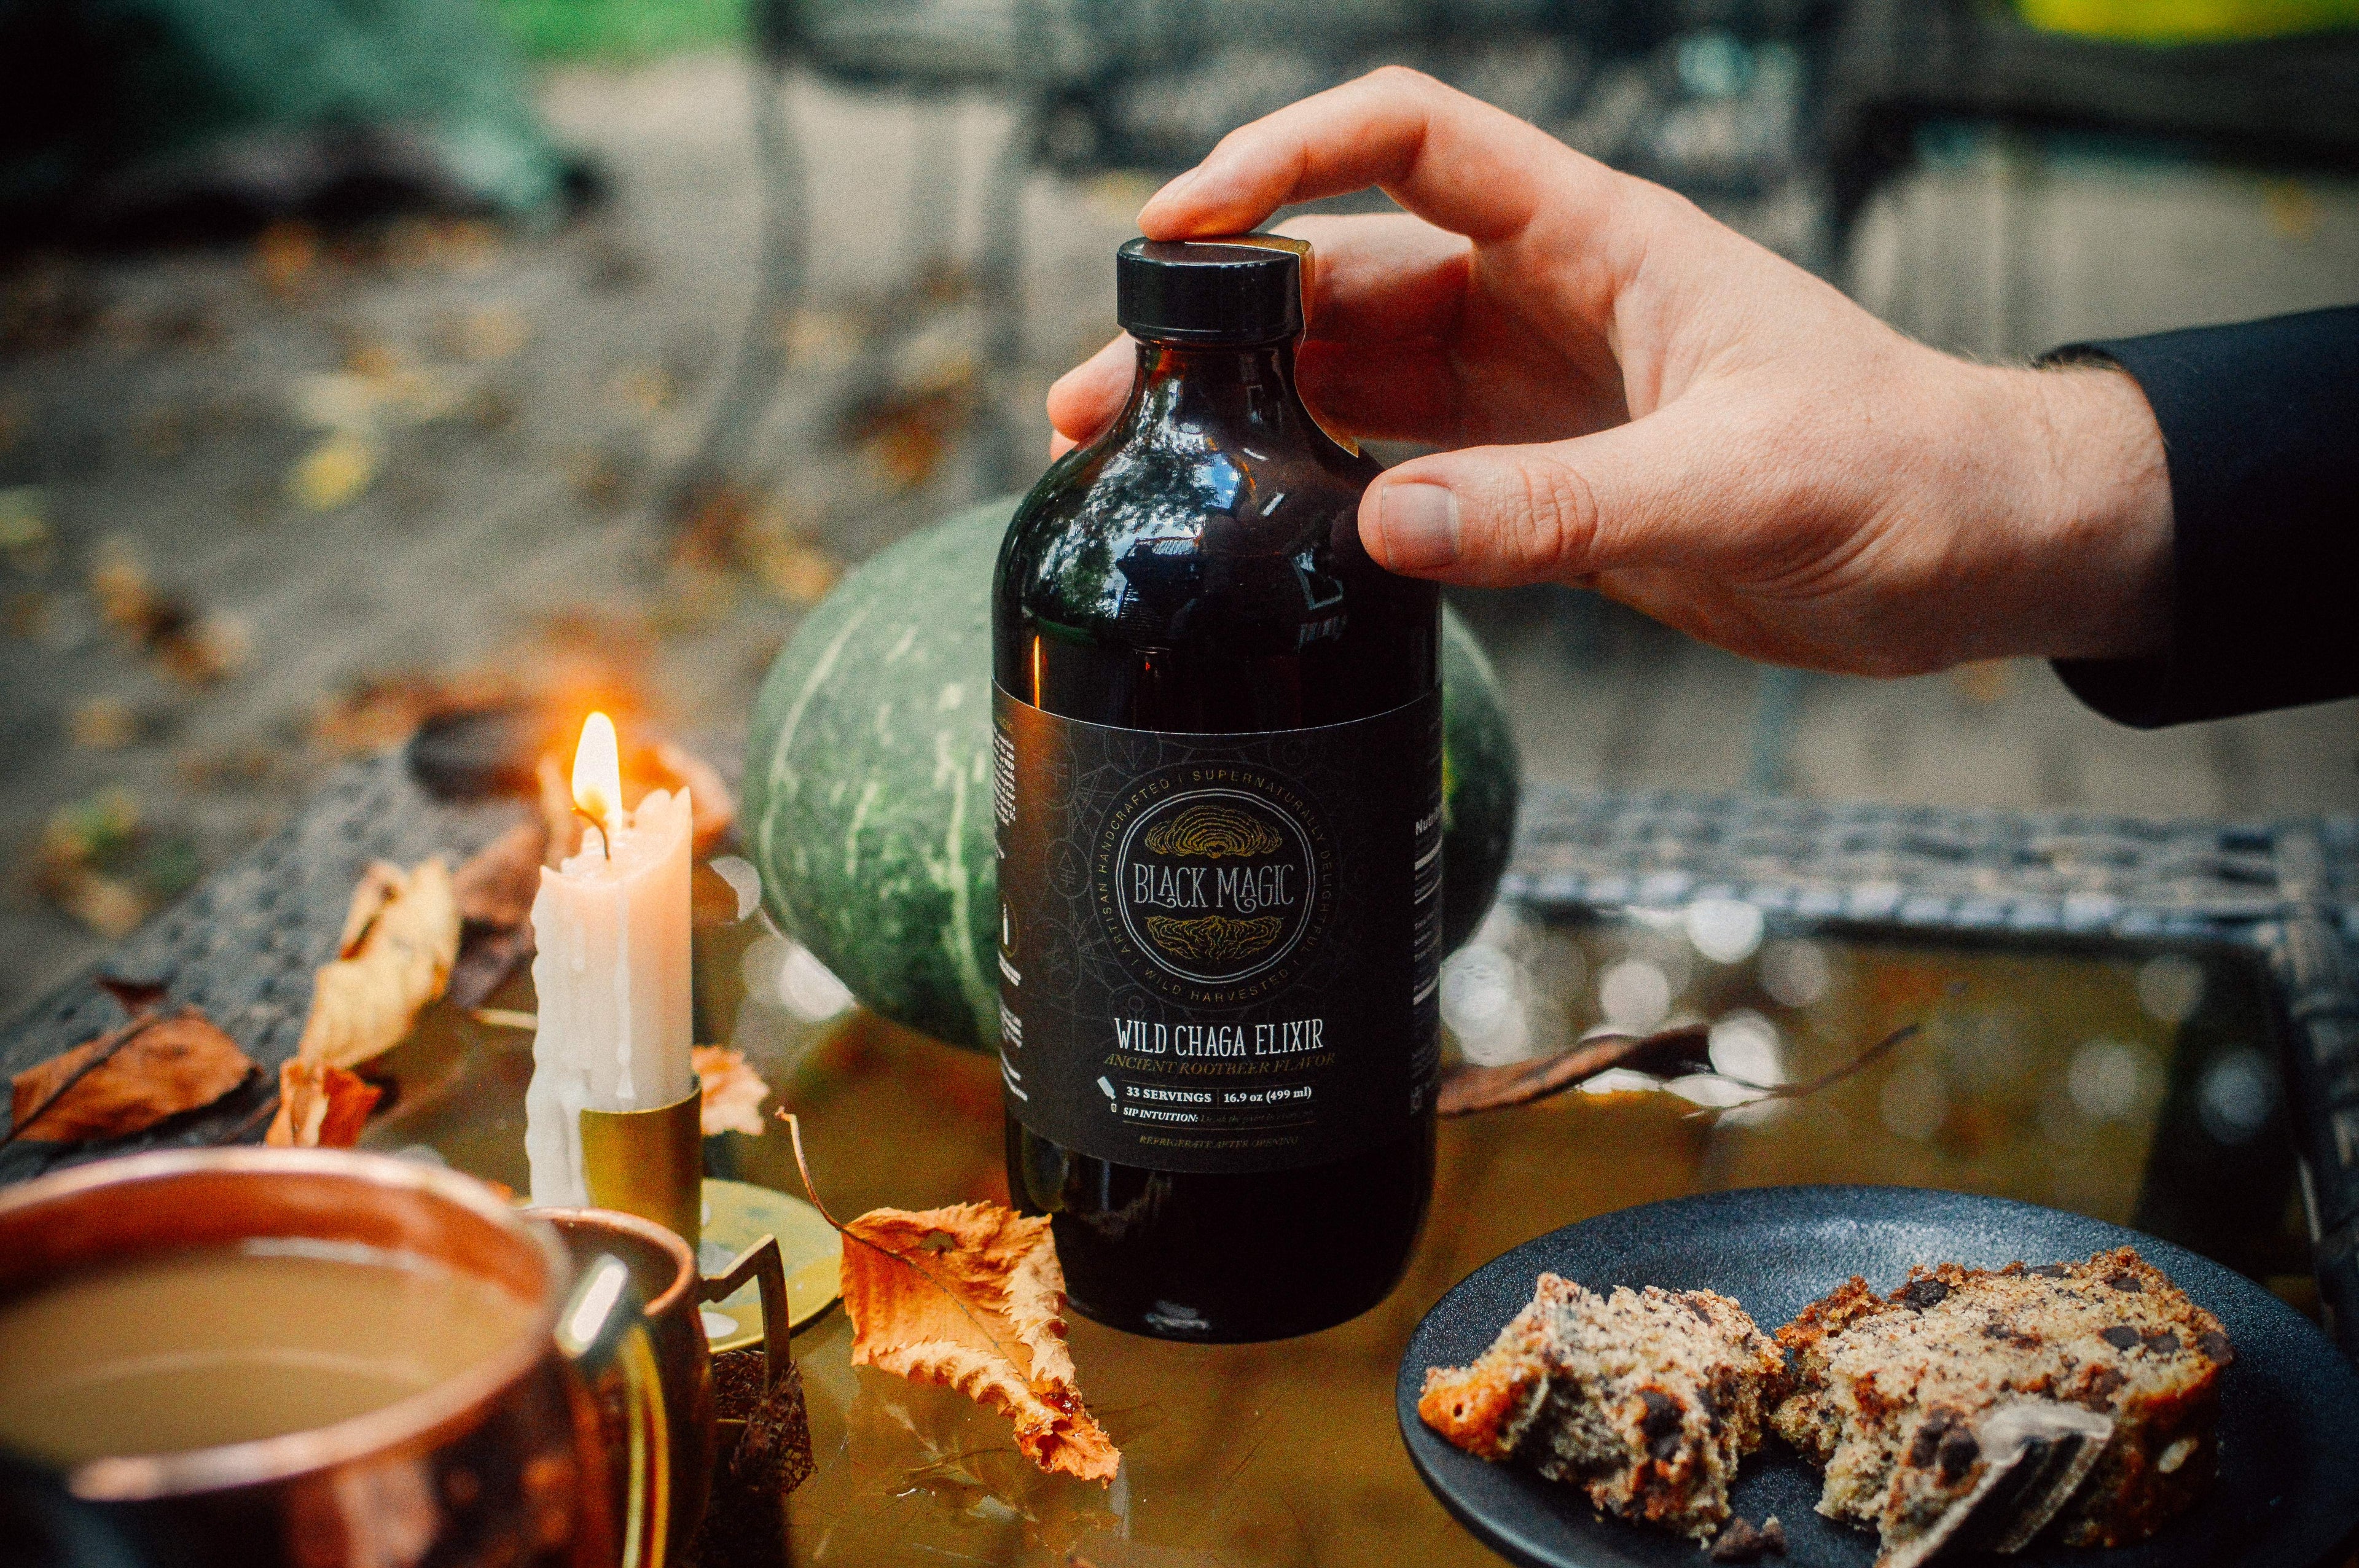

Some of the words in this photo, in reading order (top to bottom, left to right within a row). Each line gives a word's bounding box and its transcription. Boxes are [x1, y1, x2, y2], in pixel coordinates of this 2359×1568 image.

[1193, 770, 1326, 842] SUPERNATURALLY
[1098, 778, 1169, 873] HANDCRAFTED
[1133, 863, 1208, 908] BLACK
[1216, 864, 1294, 913] MAGIC
[1301, 850, 1333, 953] DELIGHTFUL
[1099, 883, 1130, 953] ARTISAN
[1144, 967, 1181, 994] WILD
[1191, 969, 1288, 1002] HARVESTED
[1114, 1017, 1167, 1054] WILD
[1175, 1025, 1246, 1056] CHAGA
[1255, 1018, 1324, 1055] ELIXIR
[1104, 1053, 1177, 1074] ANCIENT
[1125, 1086, 1140, 1098] 33
[1143, 1088, 1212, 1103] SERVINGS
[1224, 1093, 1247, 1104] 16.9
[1250, 1093, 1263, 1102] oz
[1266, 1090, 1290, 1104] (499
[1293, 1086, 1312, 1099] ml)
[1123, 1107, 1139, 1118] SIP
[1139, 1109, 1199, 1123] INTUITION:
